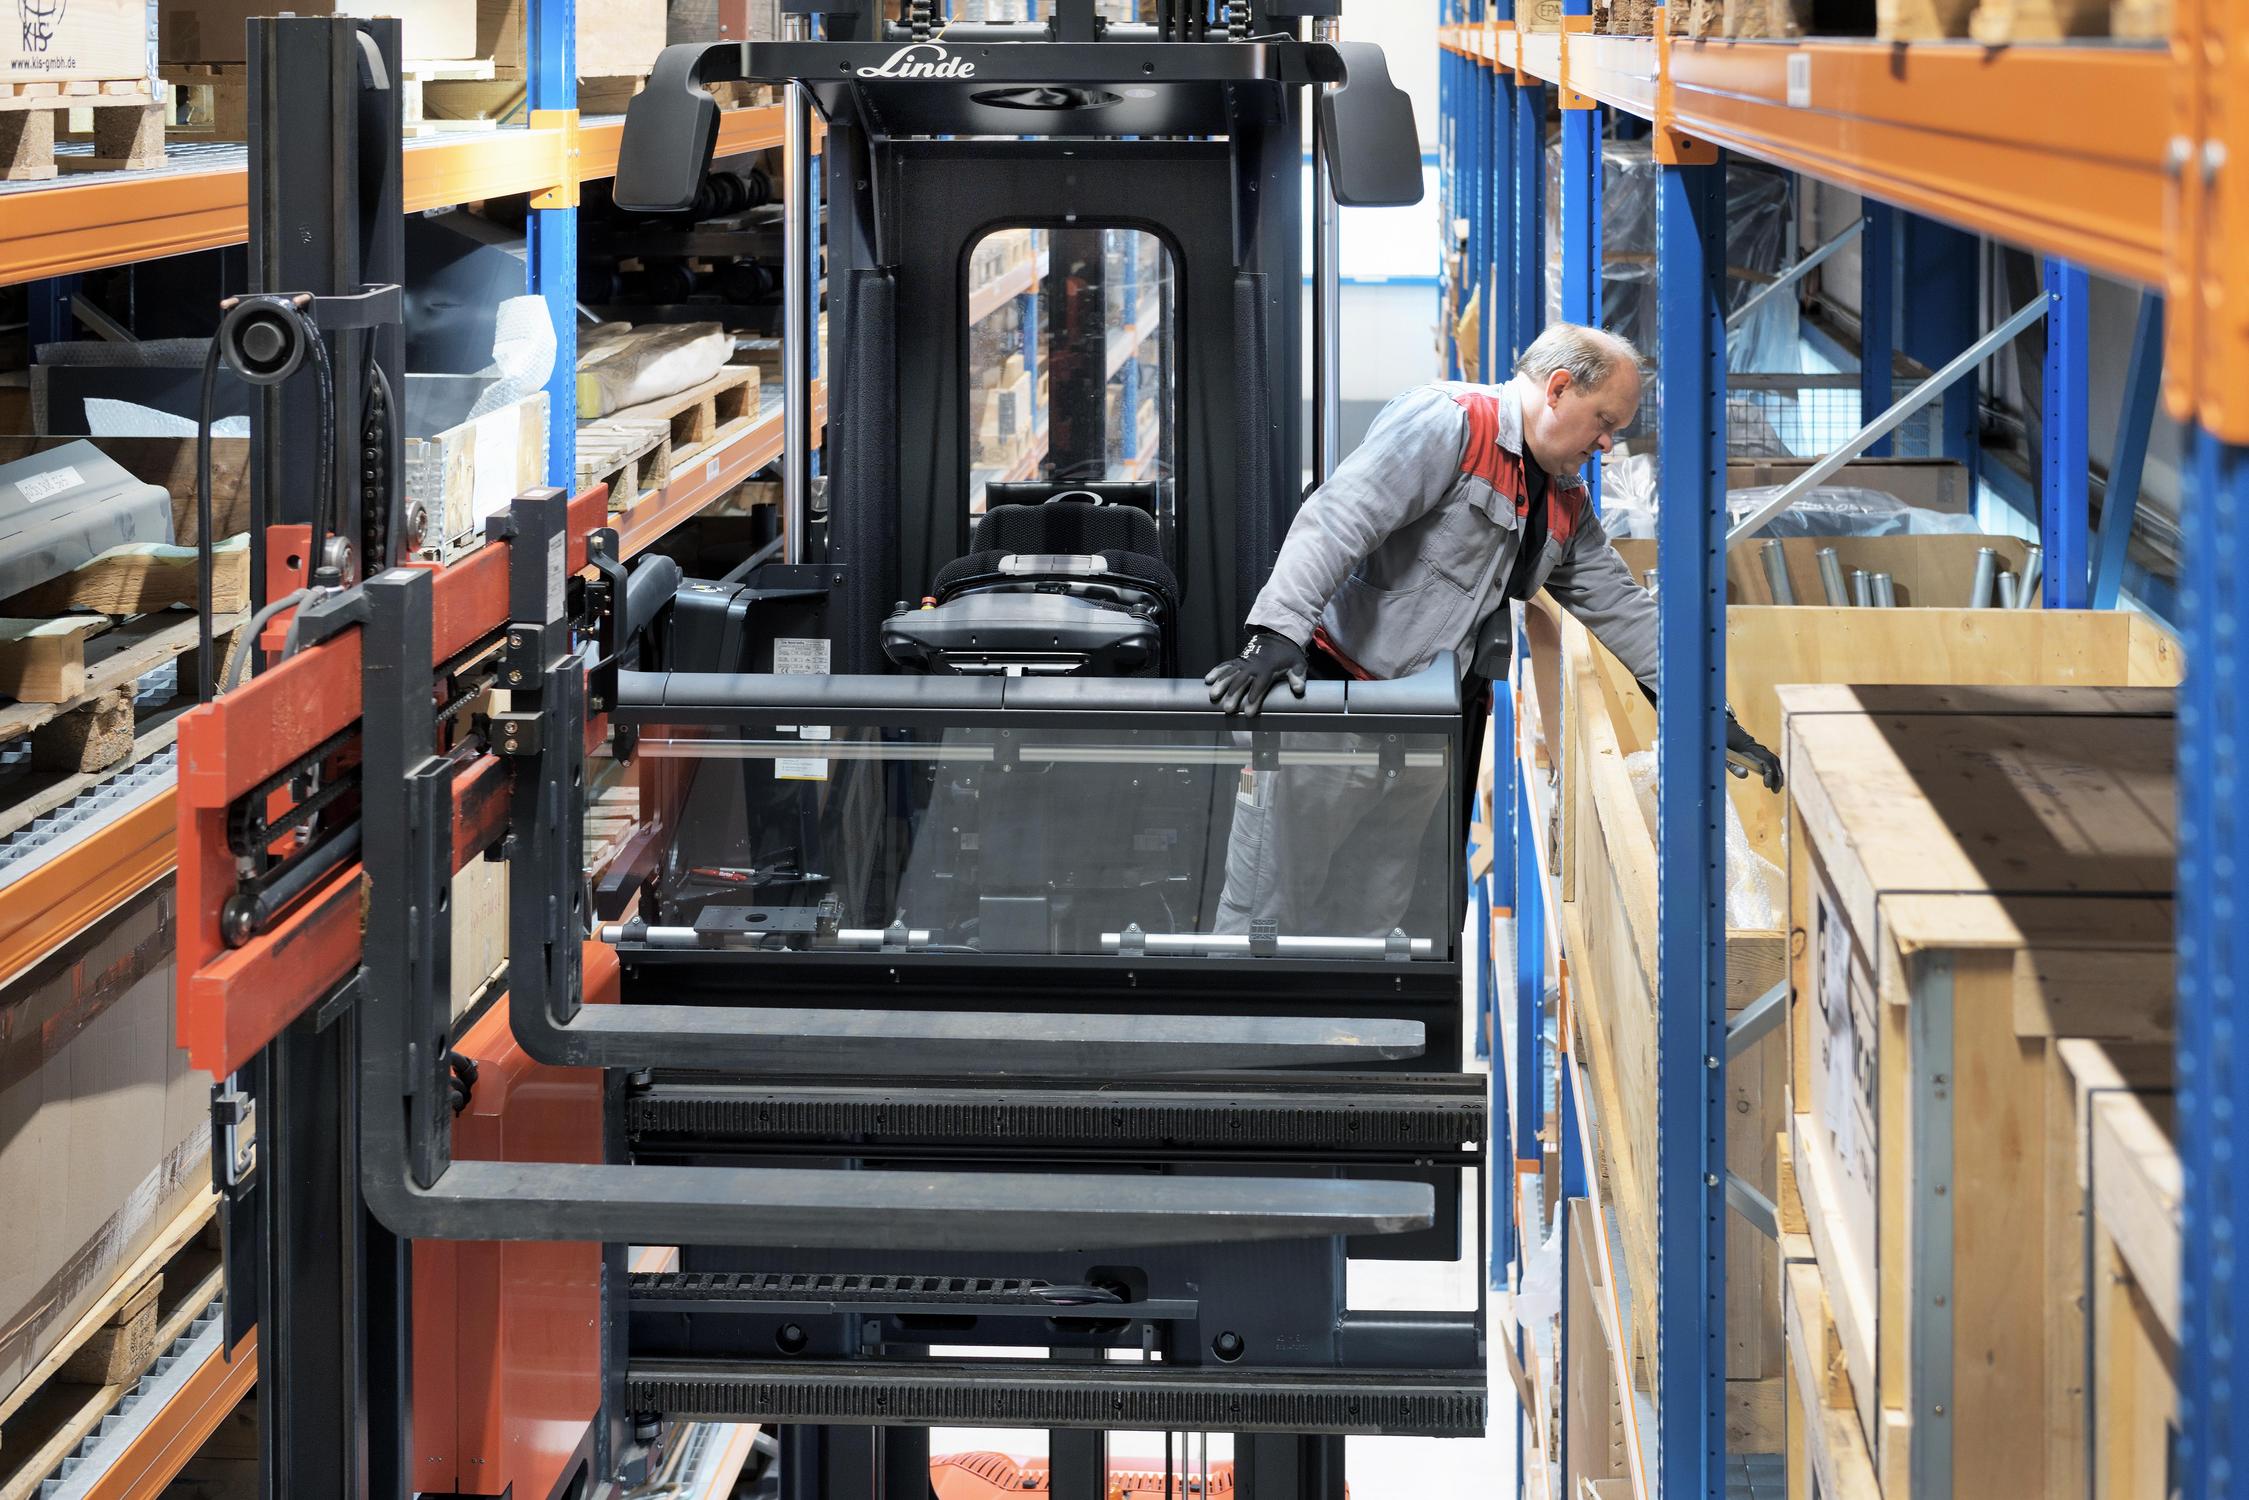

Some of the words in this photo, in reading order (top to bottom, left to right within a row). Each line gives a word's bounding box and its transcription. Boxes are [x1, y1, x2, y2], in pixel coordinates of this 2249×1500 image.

[1540, 4, 1561, 16] EPA
[22, 22, 50, 52] KIS
[11, 56, 77, 72] www.kis-gmbh.de
[856, 44, 975, 78] Linde
